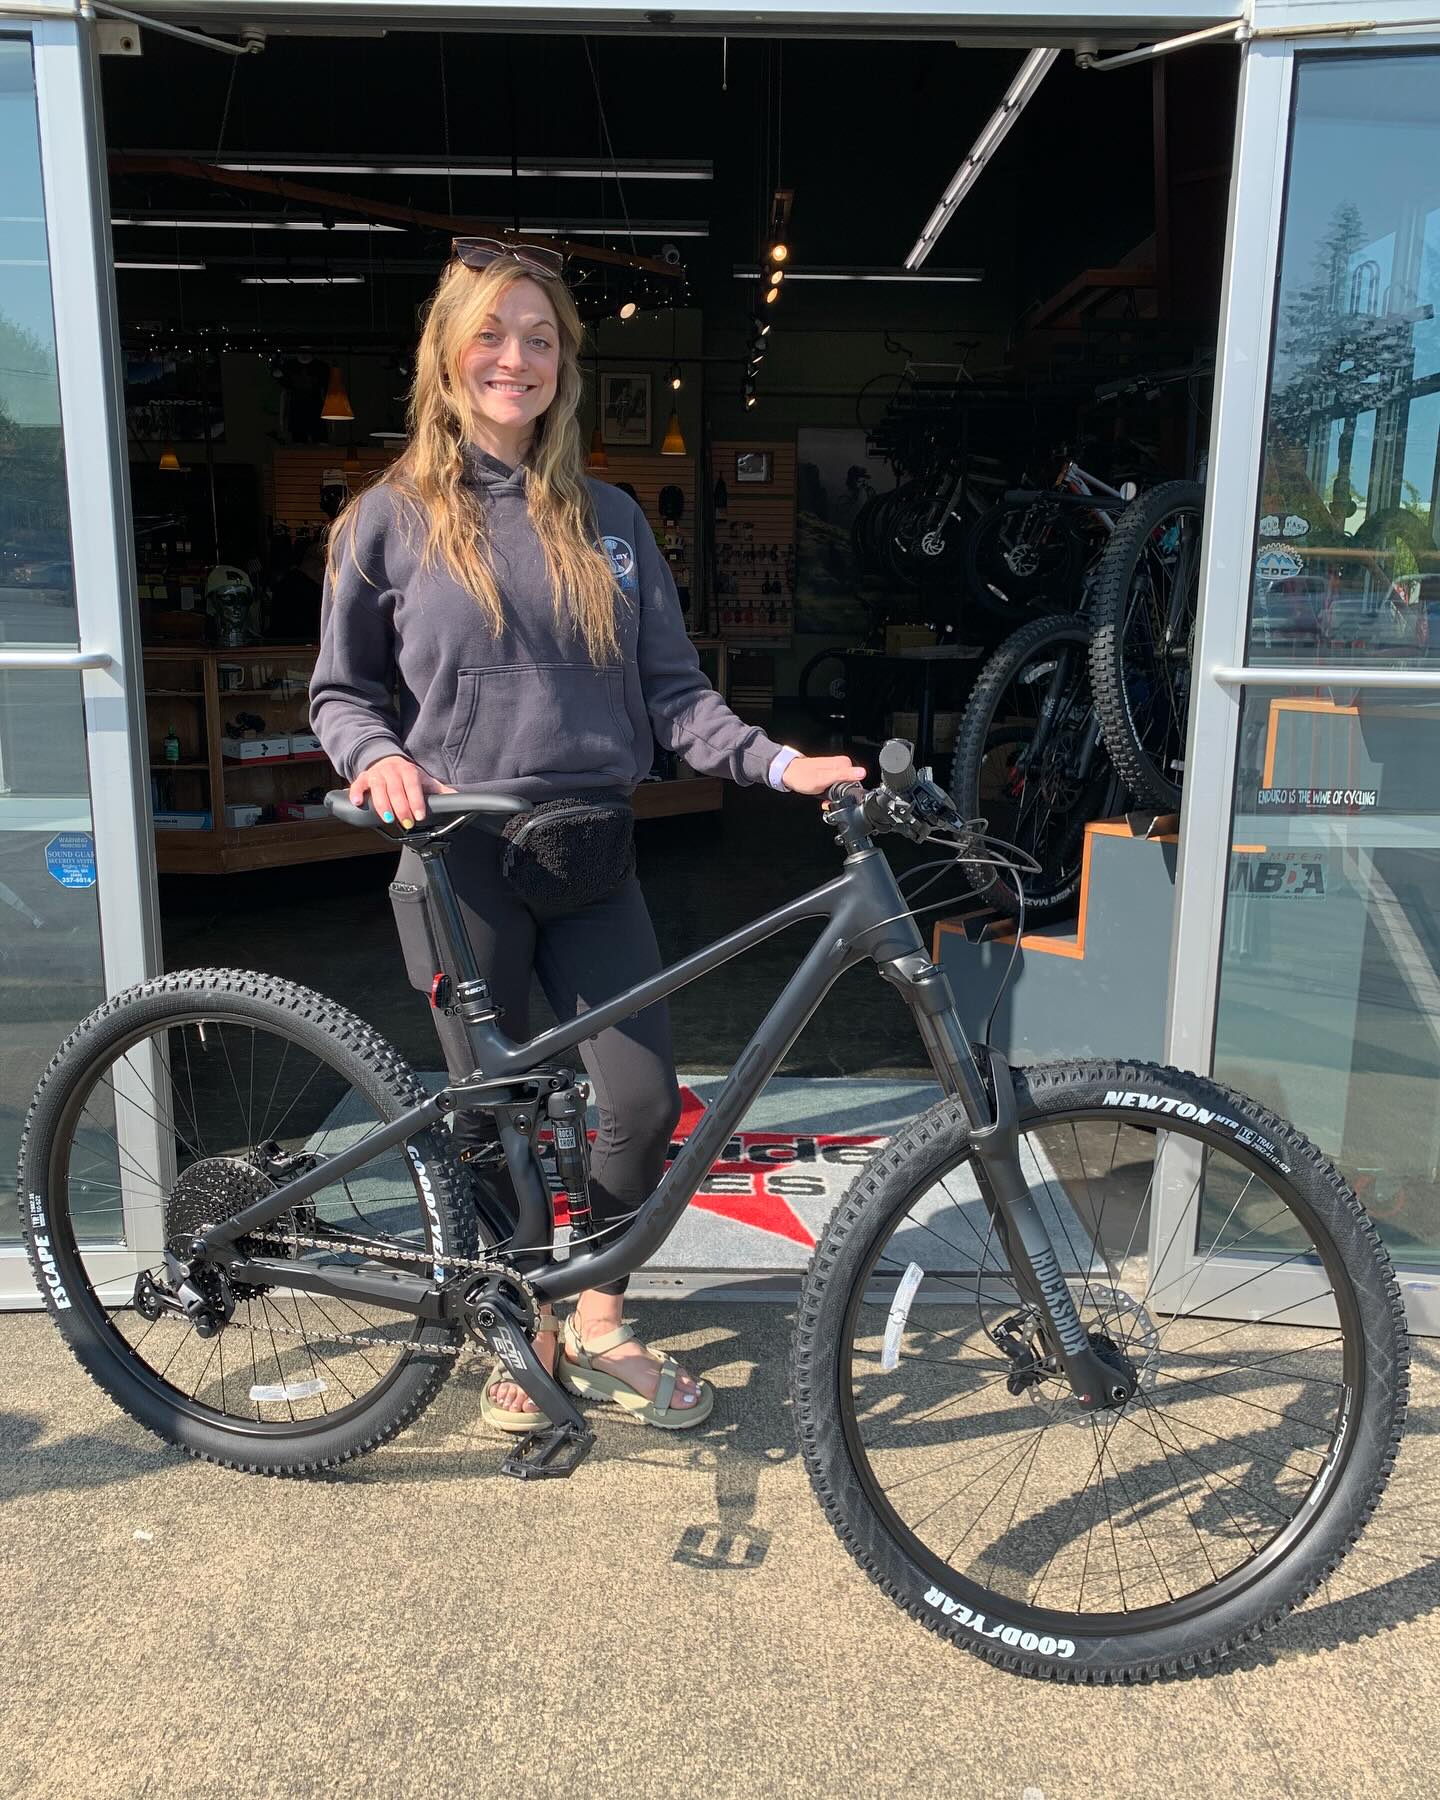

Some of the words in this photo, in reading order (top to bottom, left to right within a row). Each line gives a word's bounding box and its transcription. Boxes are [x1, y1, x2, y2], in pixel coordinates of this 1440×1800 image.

[1258, 789, 1287, 804] ENDURO
[1288, 789, 1296, 804] IS
[1298, 790, 1311, 804] THE
[1312, 790, 1331, 805] WWE
[1332, 790, 1345, 805] OF
[1344, 790, 1376, 806] CYCLING
[1240, 853, 1323, 861] MEMBER
[1102, 1091, 1217, 1125] NEWTON
[1256, 1135, 1276, 1154] TRAIL
[34, 1234, 72, 1310] ESCAPE
[1030, 1247, 1088, 1357] ROCKSHOX
[923, 1585, 1076, 1658] GOODYEAR
